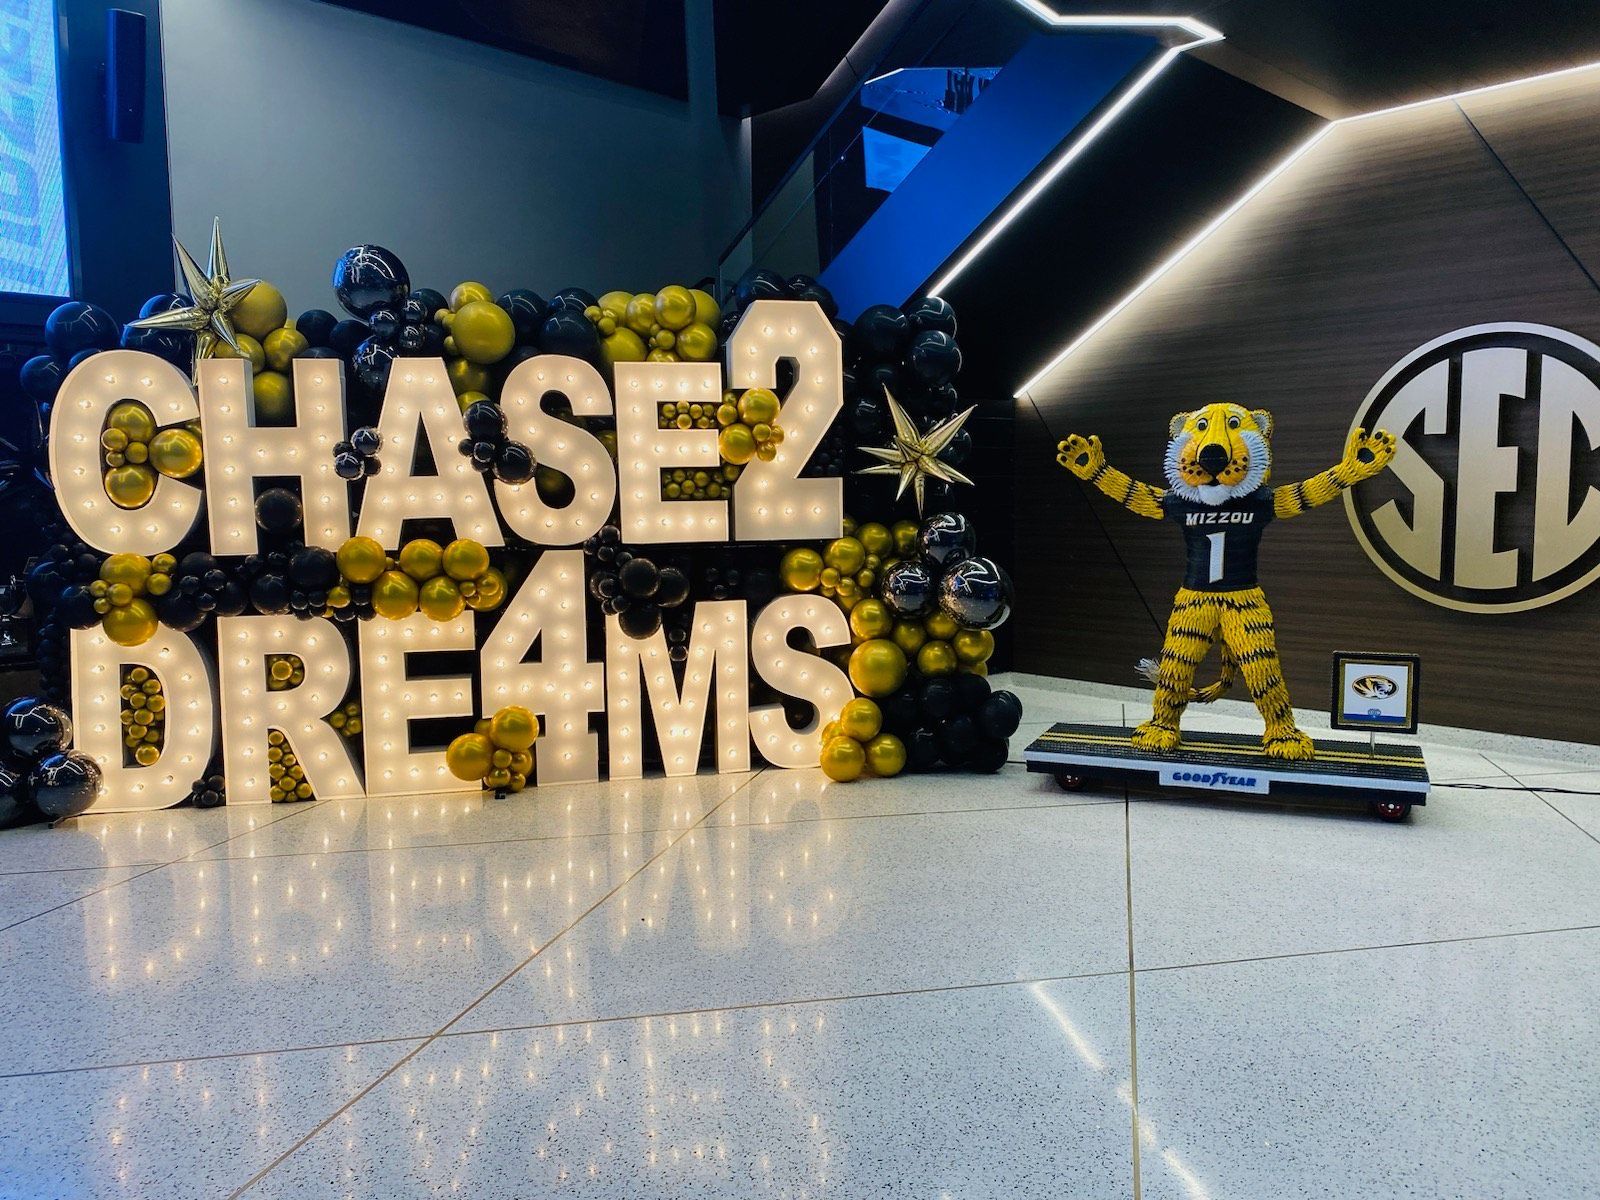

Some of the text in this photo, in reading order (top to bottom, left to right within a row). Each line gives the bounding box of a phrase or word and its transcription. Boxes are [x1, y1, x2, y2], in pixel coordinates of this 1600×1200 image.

[1368, 347, 1600, 590] SEC
[1185, 511, 1255, 527] MIZZOU
[1205, 531, 1227, 584] 1
[69, 549, 856, 814] DRE4MS
[1172, 772, 1257, 787] GOODYEAR
